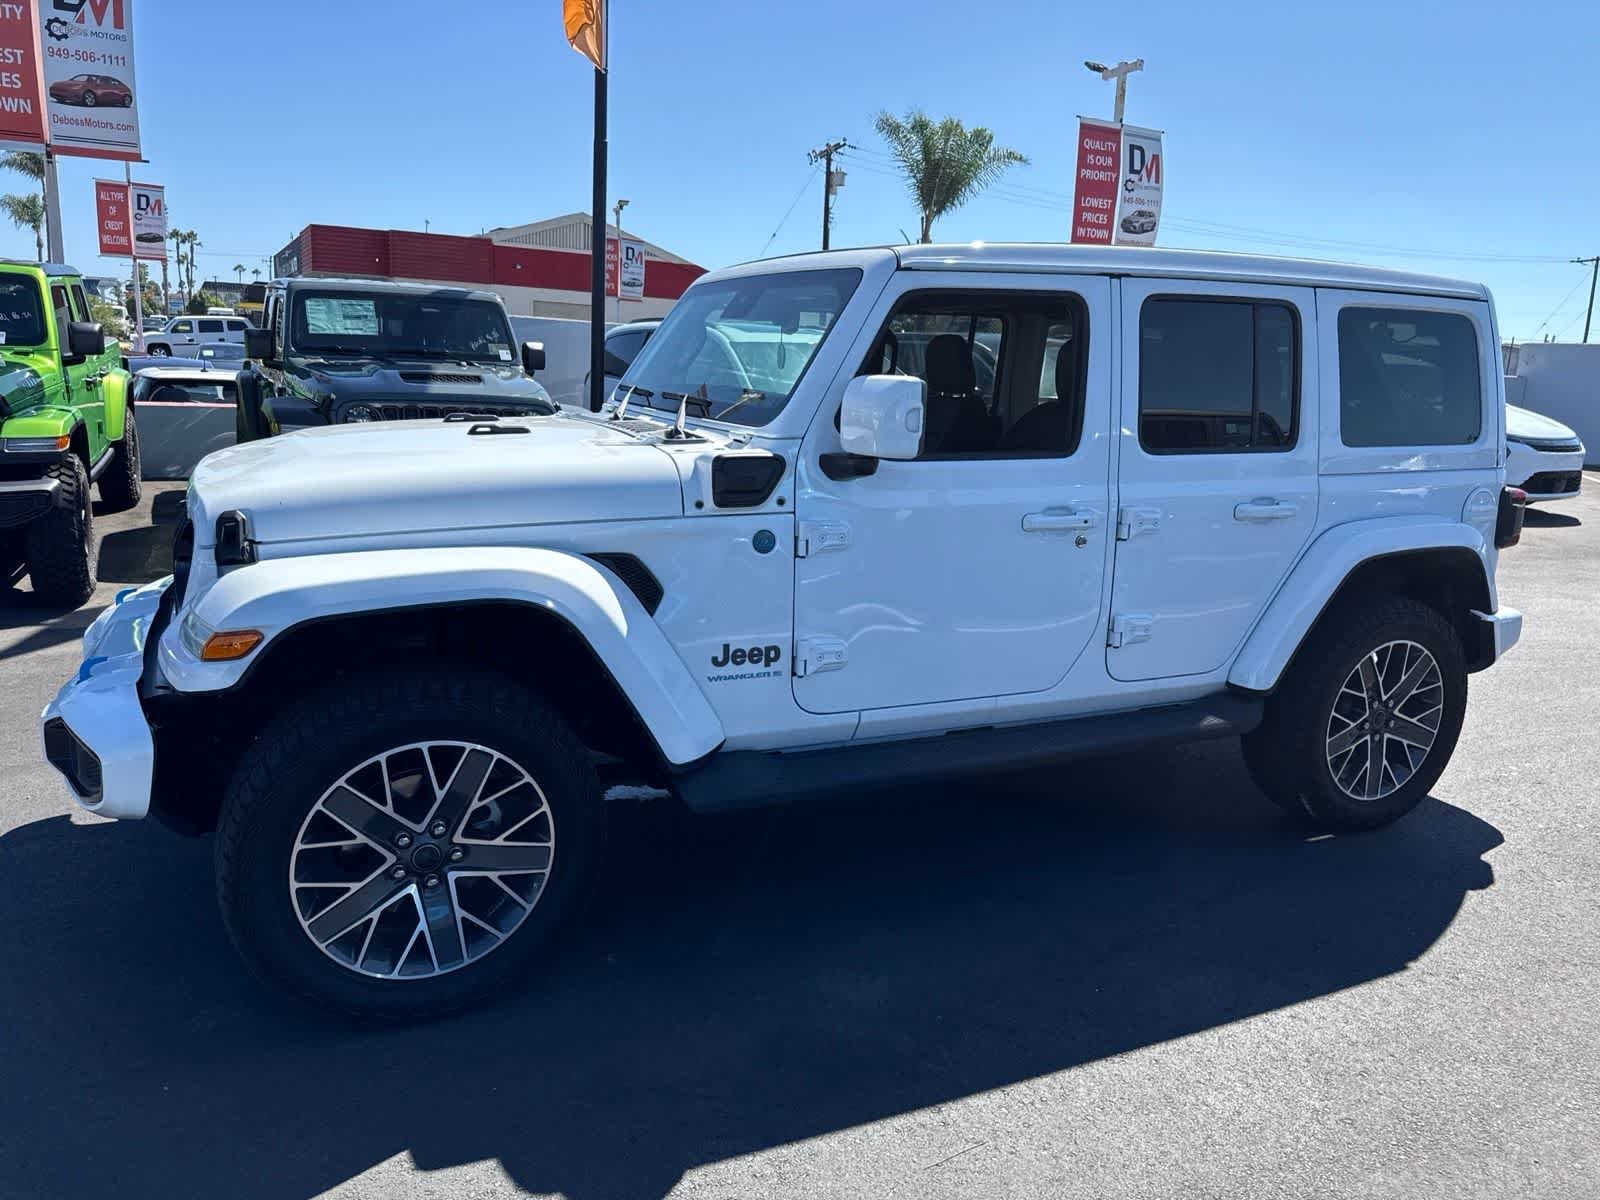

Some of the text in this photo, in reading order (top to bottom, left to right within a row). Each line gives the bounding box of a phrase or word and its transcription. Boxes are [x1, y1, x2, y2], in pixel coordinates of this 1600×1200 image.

[90, 31, 128, 42] MOTORS
[47, 46, 126, 67] 949-506-1111
[0, 72, 22, 89] ES
[0, 96, 32, 114] WN
[52, 113, 135, 132] DebossMotors.com
[1083, 138, 1117, 152] QUALITY
[1087, 154, 1113, 167] IS OUR
[1080, 169, 1117, 182] PRIORITY
[100, 191, 124, 202] ALL TYPE
[1081, 196, 1112, 209] LOWEST
[108, 205, 118, 216] OF
[1082, 212, 1108, 224] PRICES
[104, 220, 124, 231] CREDIT
[102, 234, 129, 246] WELCOME
[1077, 227, 1109, 240] IN TOWN
[711, 643, 781, 668] Jeep
[707, 670, 772, 683] WRANGLER
